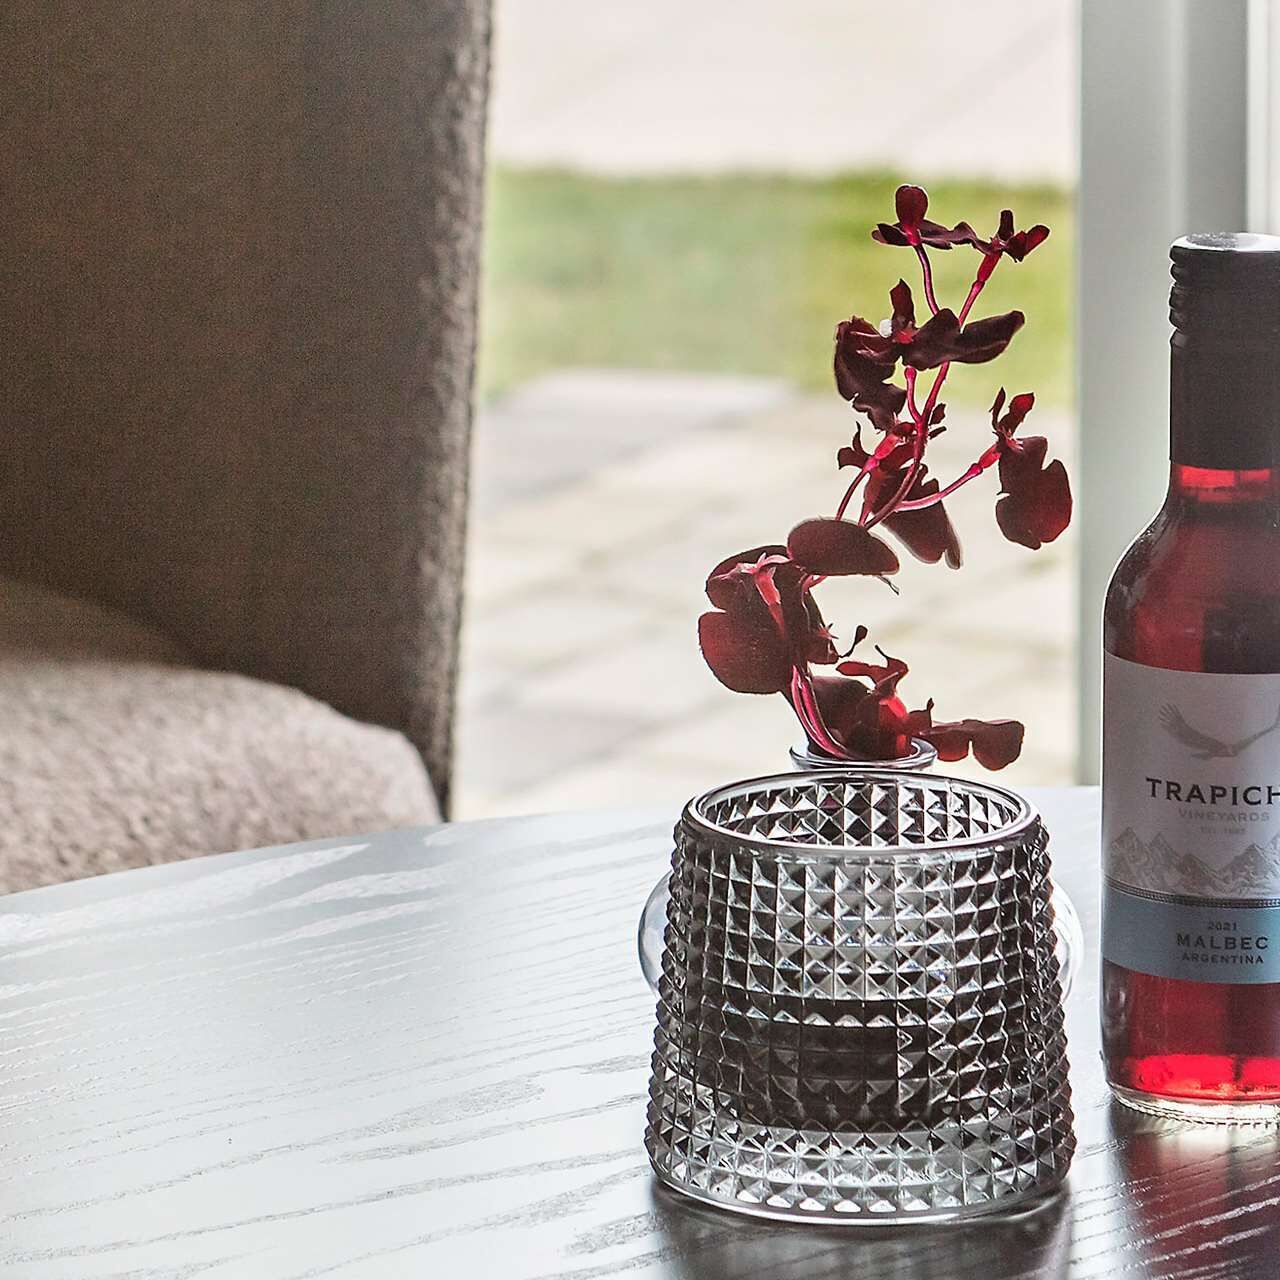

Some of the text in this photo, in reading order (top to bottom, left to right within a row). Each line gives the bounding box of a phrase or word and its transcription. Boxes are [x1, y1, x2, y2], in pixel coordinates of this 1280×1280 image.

[1178, 808, 1270, 822] VINEYARDS
[1176, 932, 1269, 950] MALBEC
[1181, 952, 1265, 965] ARGENTINA
